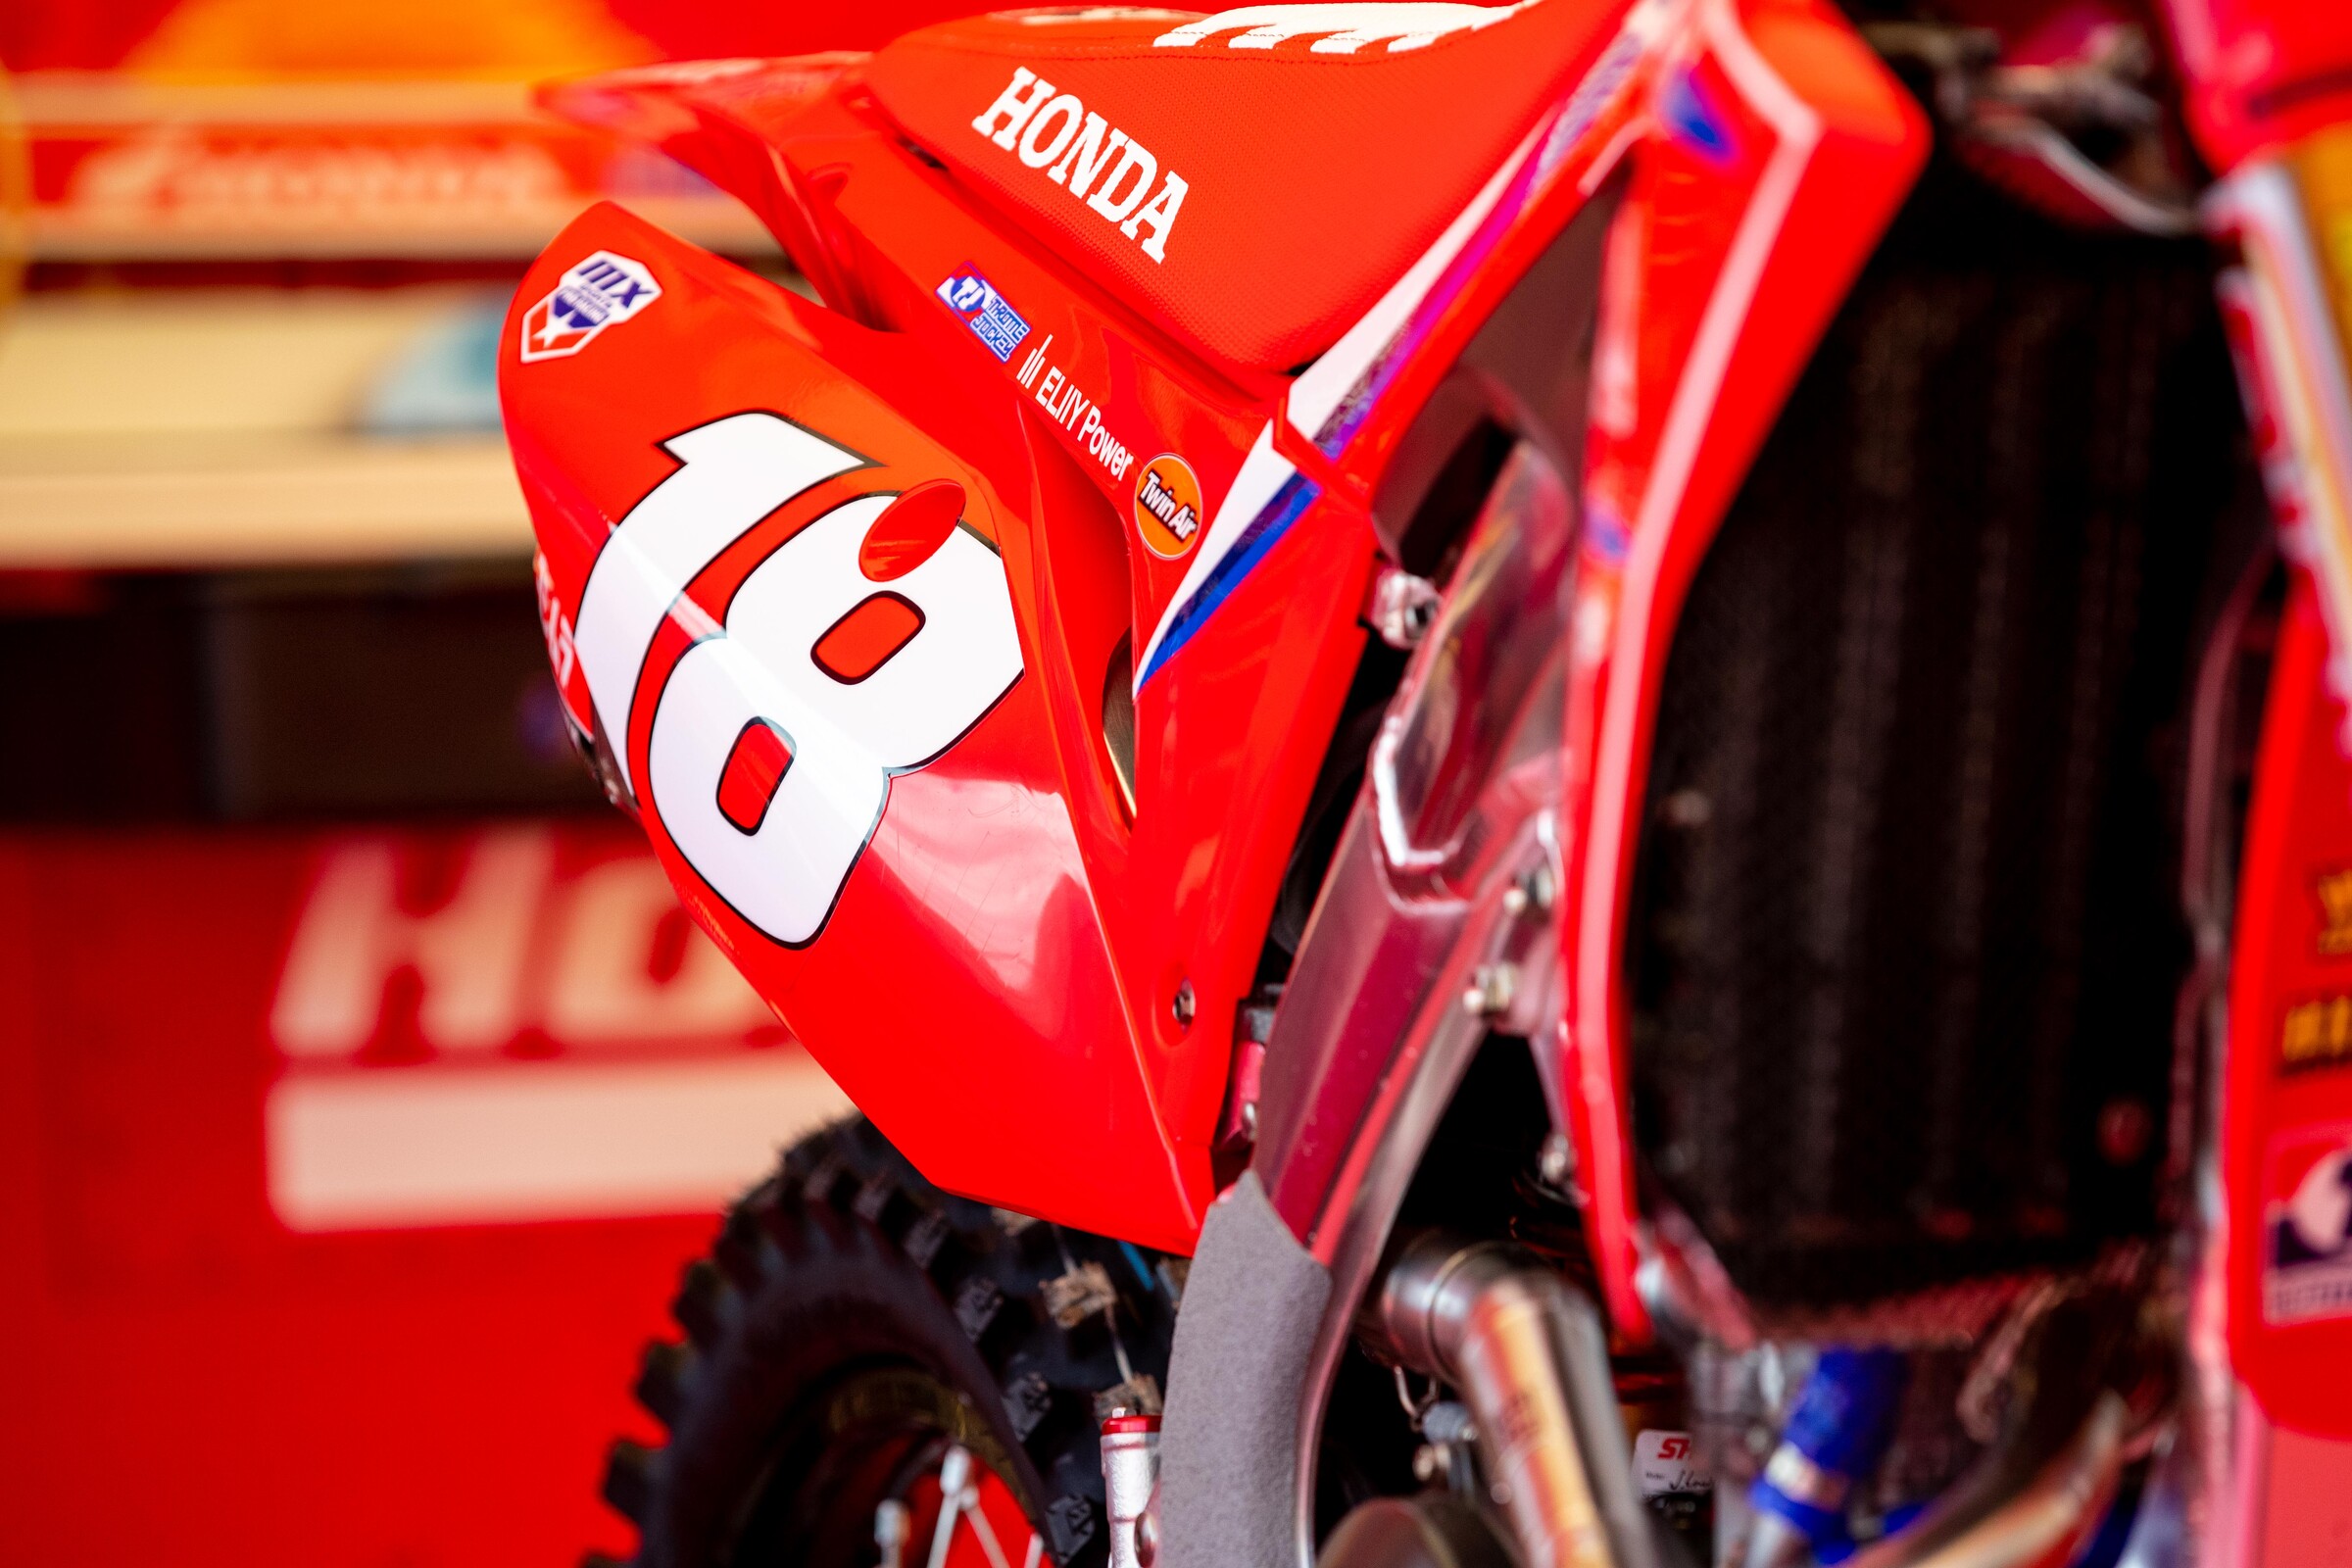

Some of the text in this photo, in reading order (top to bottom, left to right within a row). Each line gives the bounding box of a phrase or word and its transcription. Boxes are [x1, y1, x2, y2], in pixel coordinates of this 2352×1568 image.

[971, 66, 1189, 265] HONDA
[577, 260, 654, 310] MX
[970, 311, 1017, 363] JOCKEY
[1077, 405, 1135, 481] Power
[1139, 469, 1199, 542] Twin Air
[572, 408, 1026, 951] 18
